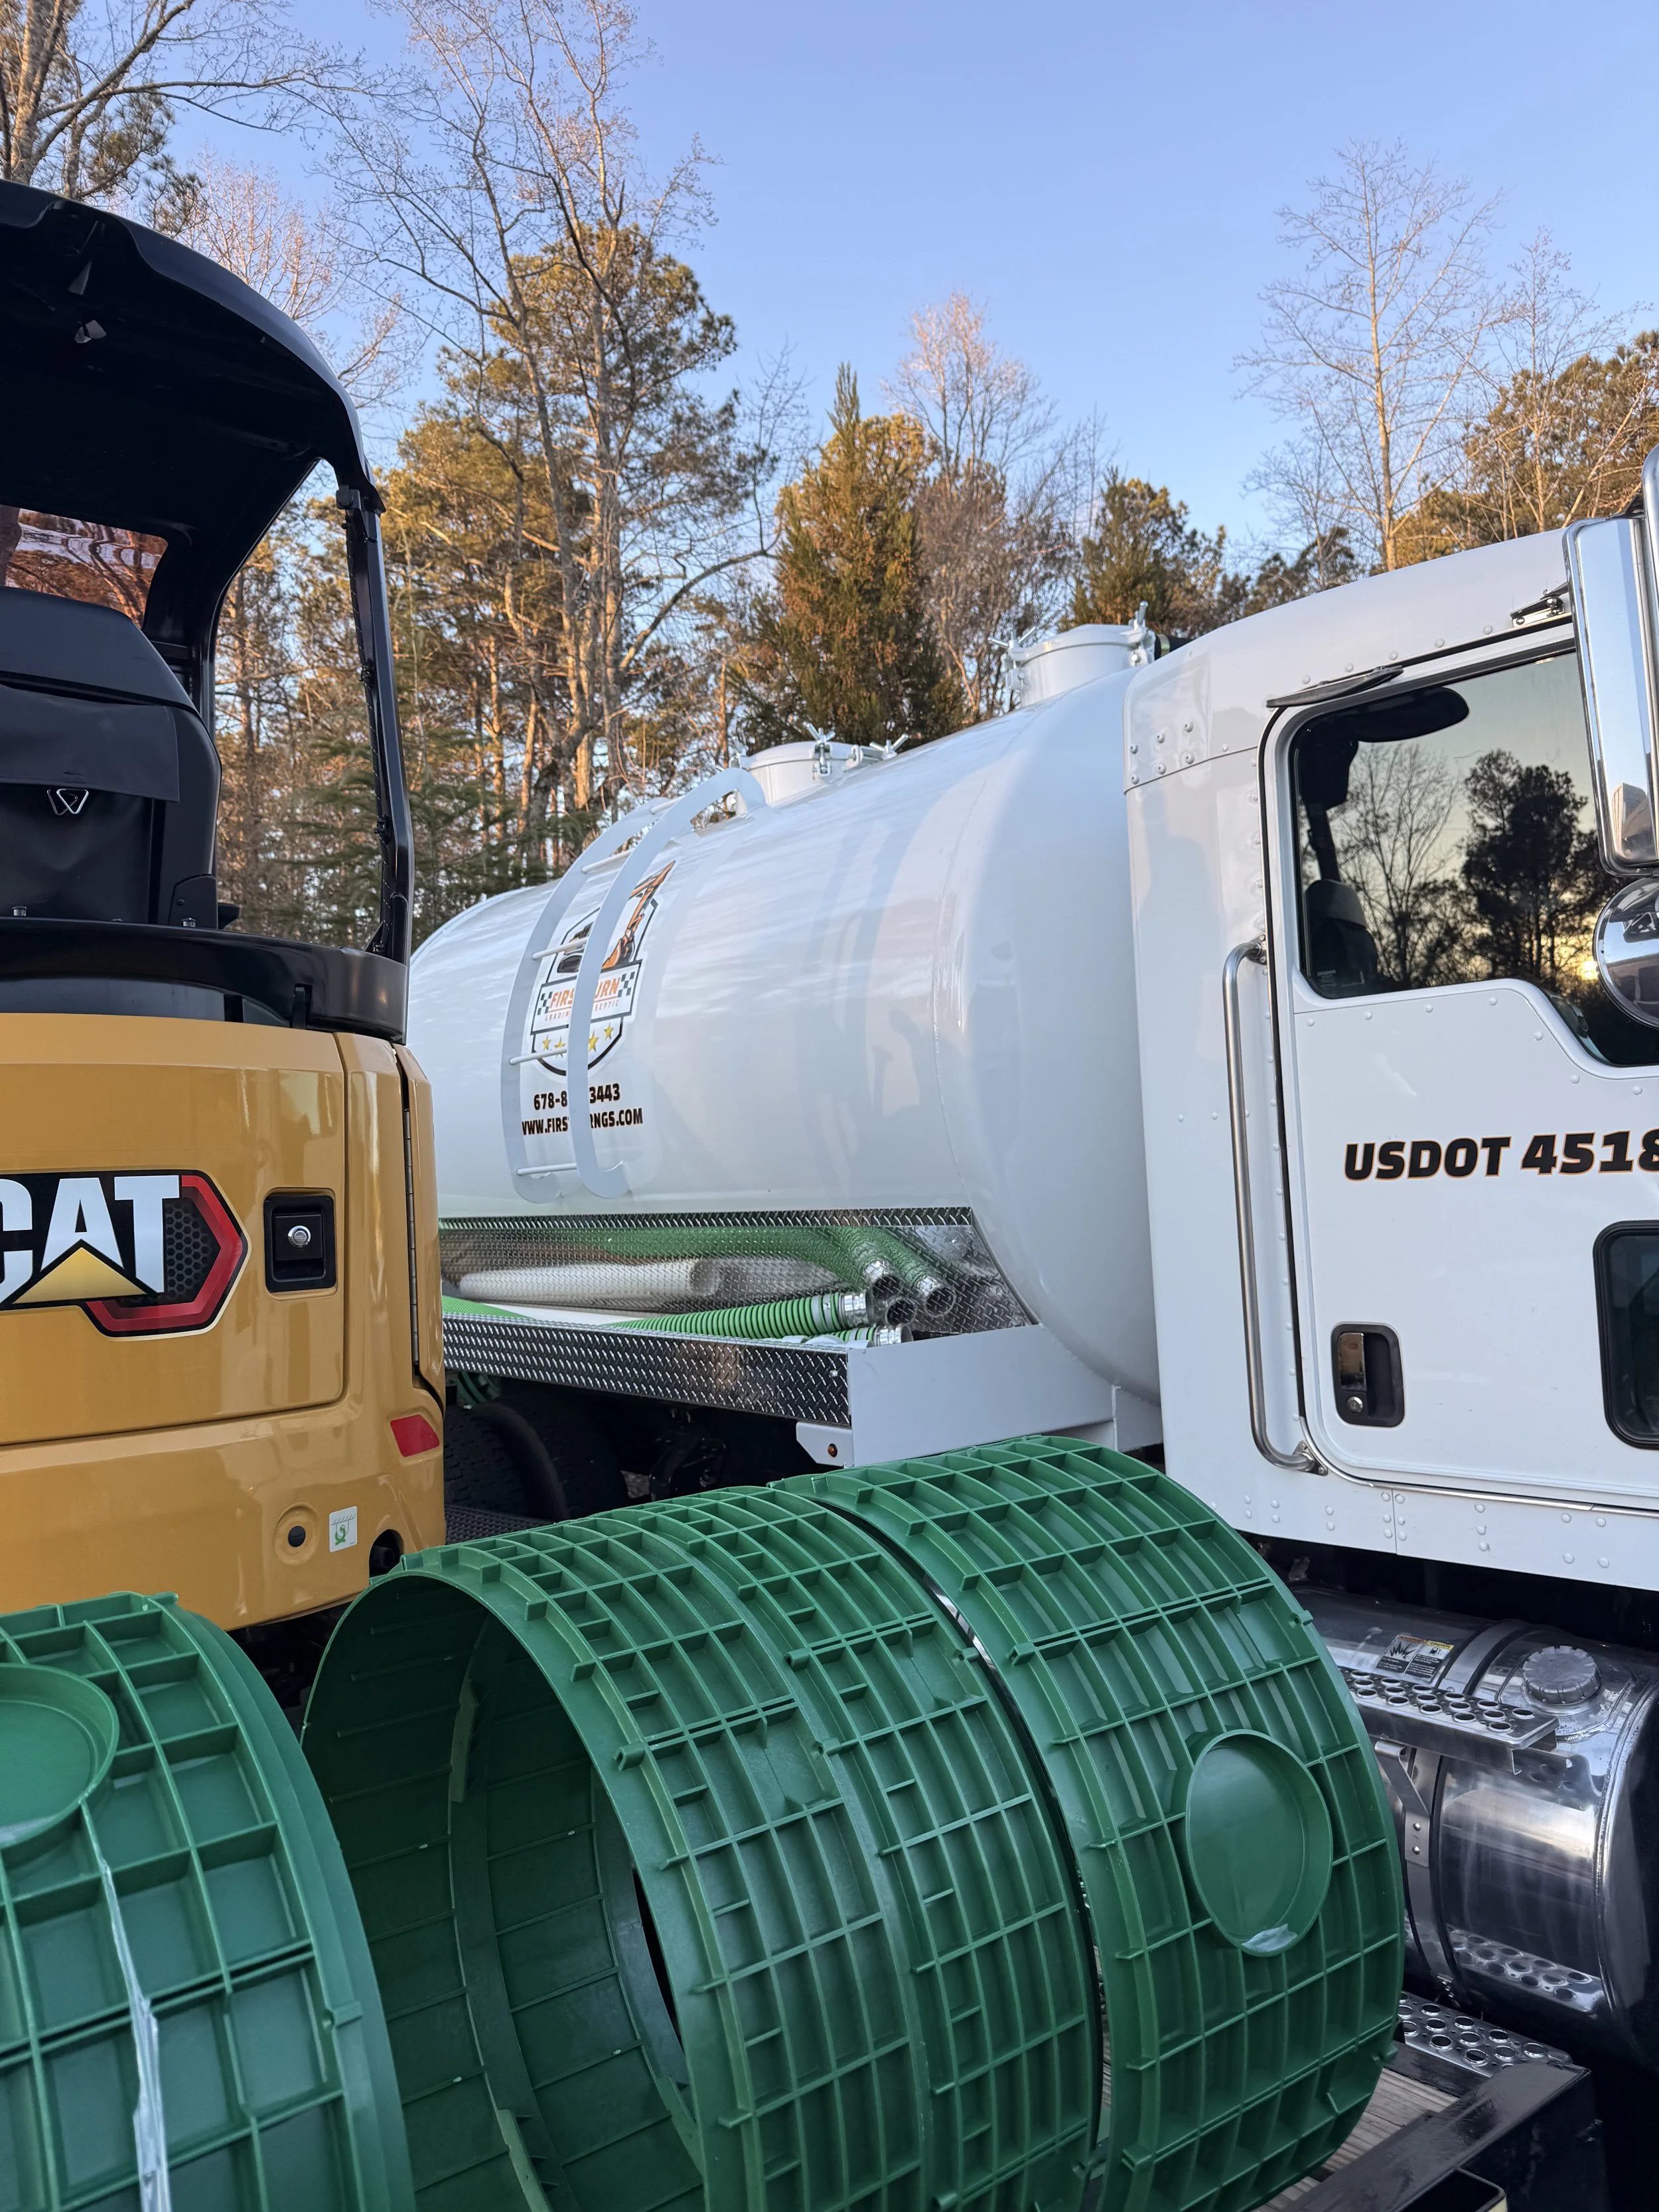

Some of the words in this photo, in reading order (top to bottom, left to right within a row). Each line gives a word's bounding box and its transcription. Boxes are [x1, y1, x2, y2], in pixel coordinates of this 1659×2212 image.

[544, 1011, 571, 1022] GRADIN
[594, 999, 620, 1011] SEPTIC
[550, 989, 575, 1008] FIRS
[534, 1083, 620, 1110] 678-83443
[522, 1108, 643, 1136] WWW.FIRSRNGS.COM
[1343, 1136, 1512, 1181] USDOT
